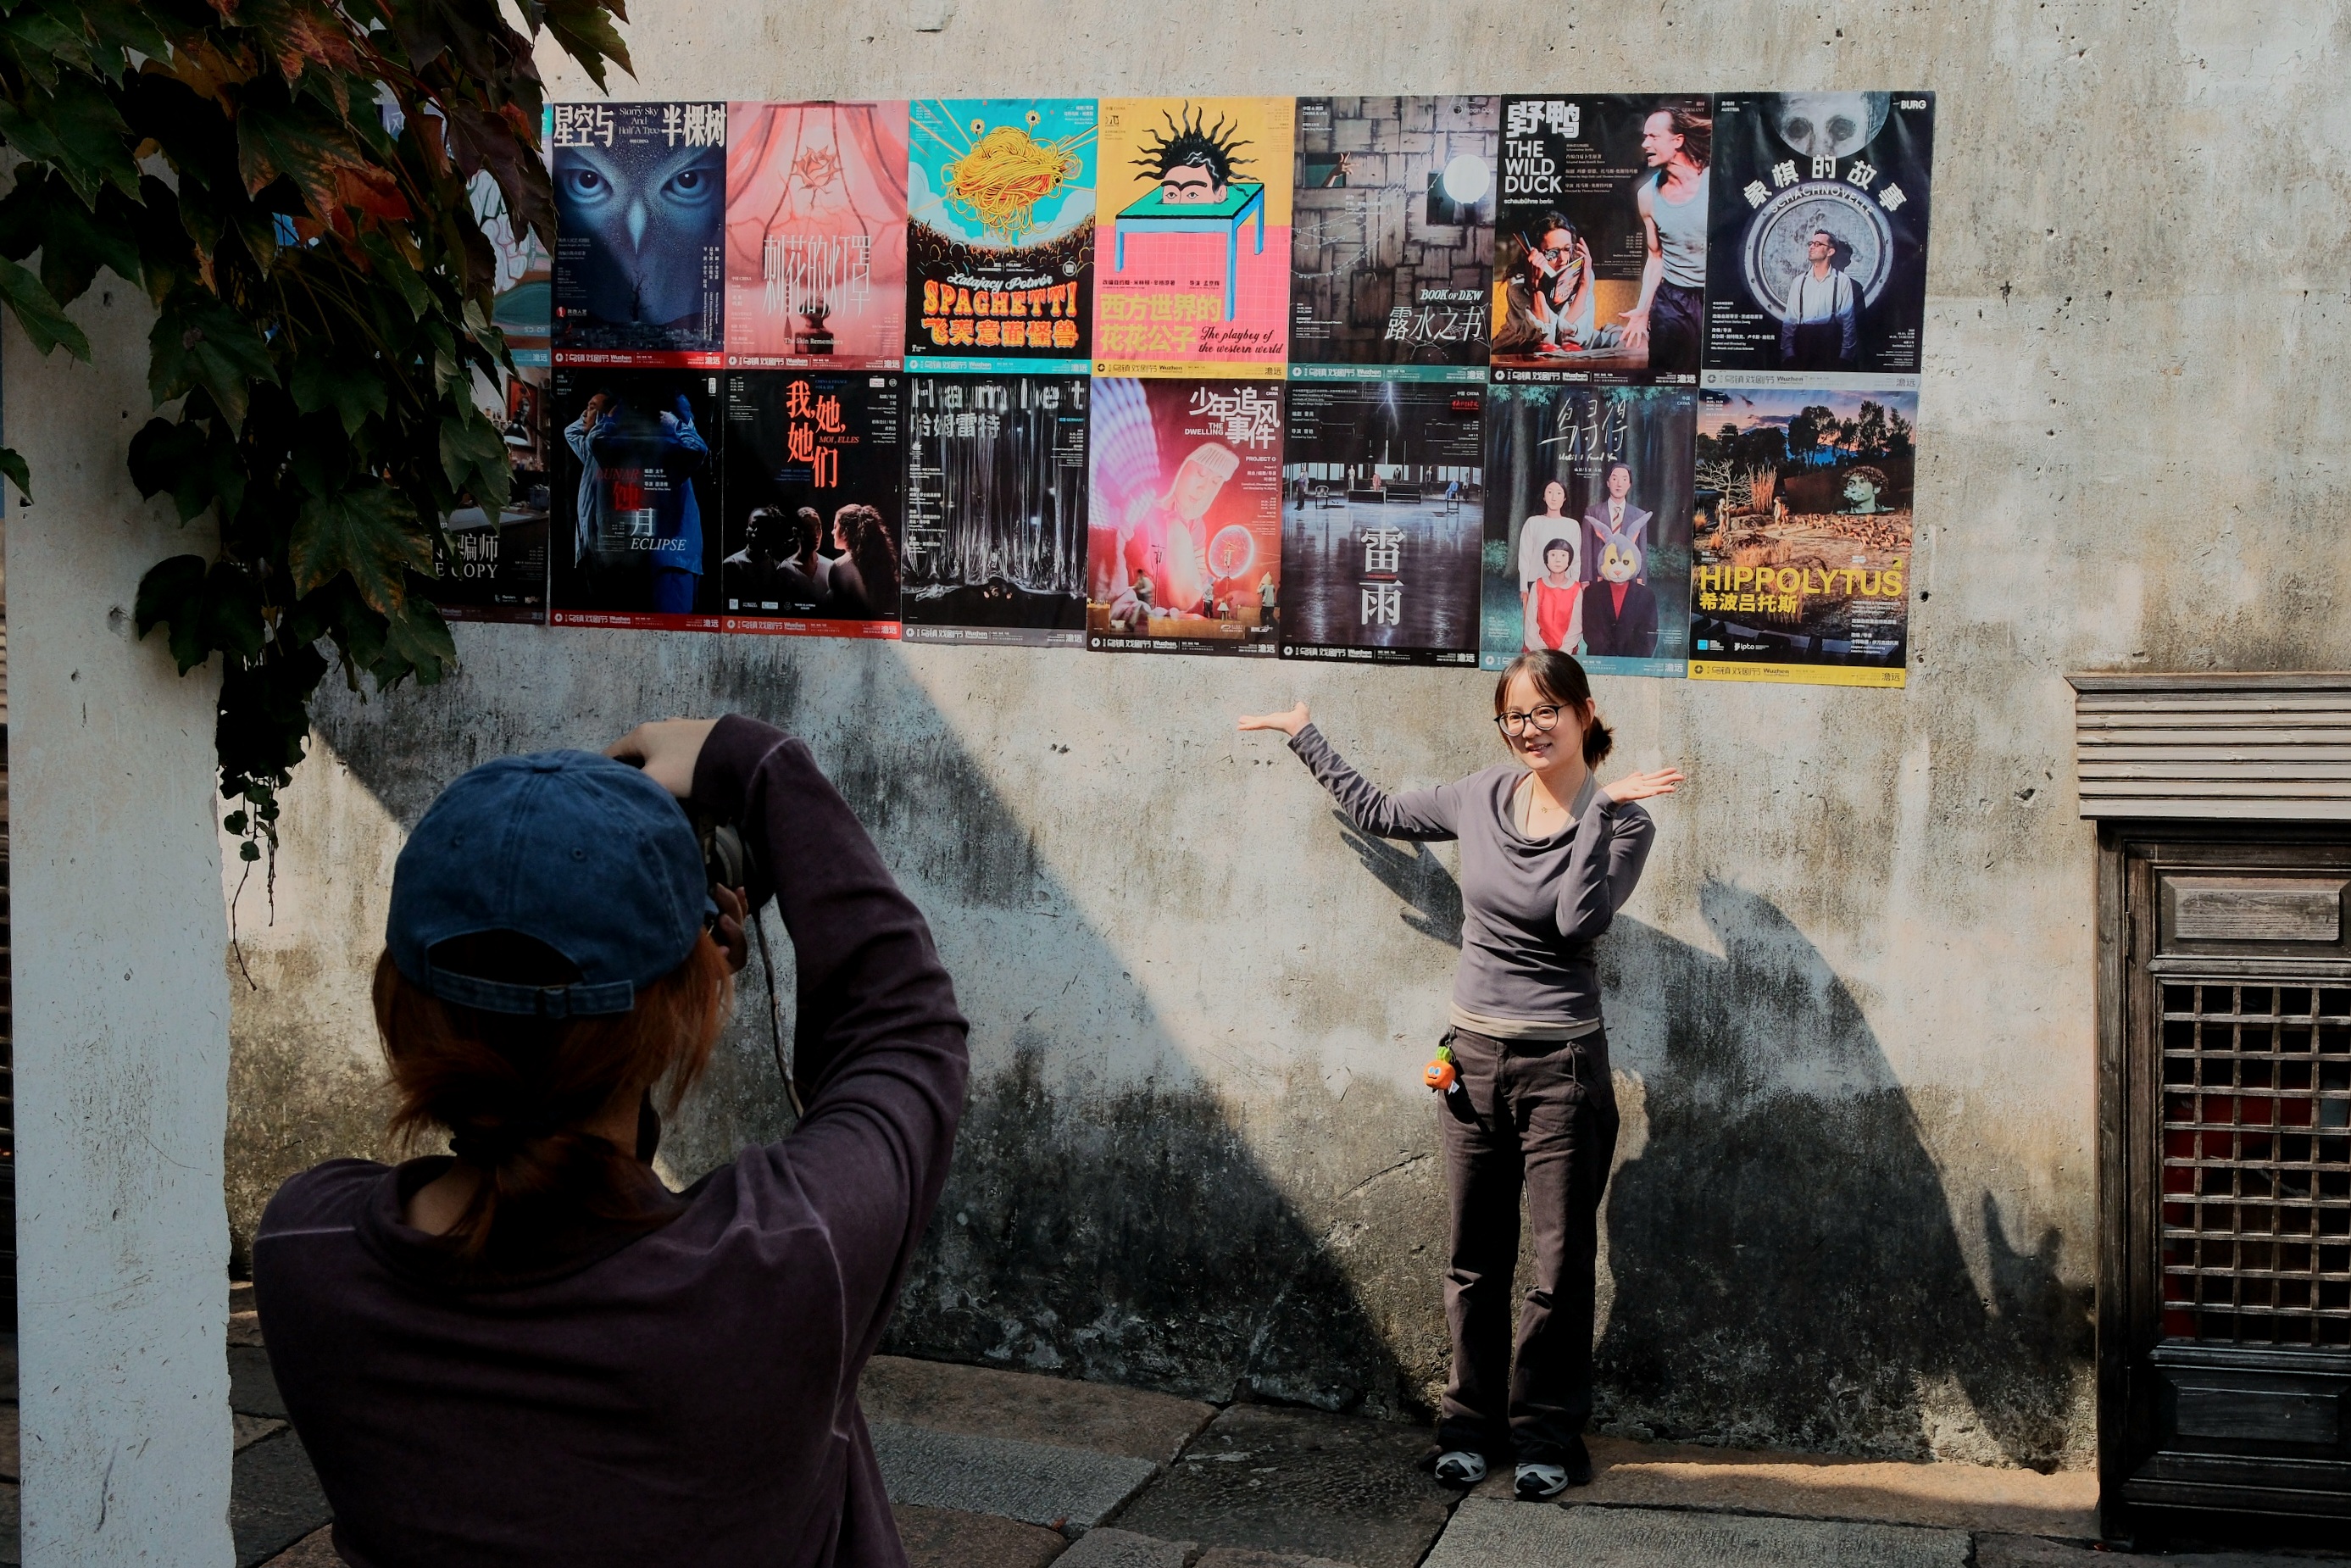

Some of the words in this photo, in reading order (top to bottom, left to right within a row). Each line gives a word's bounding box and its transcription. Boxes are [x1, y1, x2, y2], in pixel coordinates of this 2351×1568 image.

[620, 107, 642, 117] Starry
[644, 107, 659, 117] Sky
[1506, 100, 1580, 138] 野鸭
[1901, 100, 1927, 109] BURG
[553, 104, 614, 147] 星空与
[661, 103, 727, 147] 半棵树
[631, 116, 647, 125] And
[1505, 140, 1544, 158] THE
[1505, 158, 1555, 175] WILD
[1504, 176, 1563, 194] DUCK
[1743, 154, 1907, 212] 象棋的故事
[1769, 185, 1875, 216] SCHACHNOVELLE
[763, 234, 871, 318] 刺花的灯罩
[923, 279, 1078, 317] SPAGHETTI
[1100, 293, 1222, 322] 西方世界的
[1420, 289, 1448, 300] BOOK
[1458, 290, 1484, 300] DEW
[921, 317, 1079, 349] 飞天意面怪兽
[1099, 323, 1197, 353] 花花公子
[1200, 325, 1220, 341] The
[1221, 330, 1260, 343] playboy
[1263, 330, 1275, 344] of
[1385, 305, 1485, 342] 露水之书
[1198, 343, 1214, 354] the
[1216, 345, 1252, 354] western
[1255, 343, 1284, 354] world
[911, 378, 1084, 410] Hamlet
[1189, 386, 1280, 428] 少年追风
[837, 436, 860, 444] ELLES
[910, 413, 1000, 439] 哈姆雷特
[1225, 415, 1276, 450] 事件
[630, 506, 654, 537] 月
[630, 538, 687, 551] ECLIPSE
[1359, 526, 1406, 626] 雷雨
[1700, 565, 1902, 597] HIPPOLYTUS
[1699, 592, 1798, 613] 希波吕托斯
